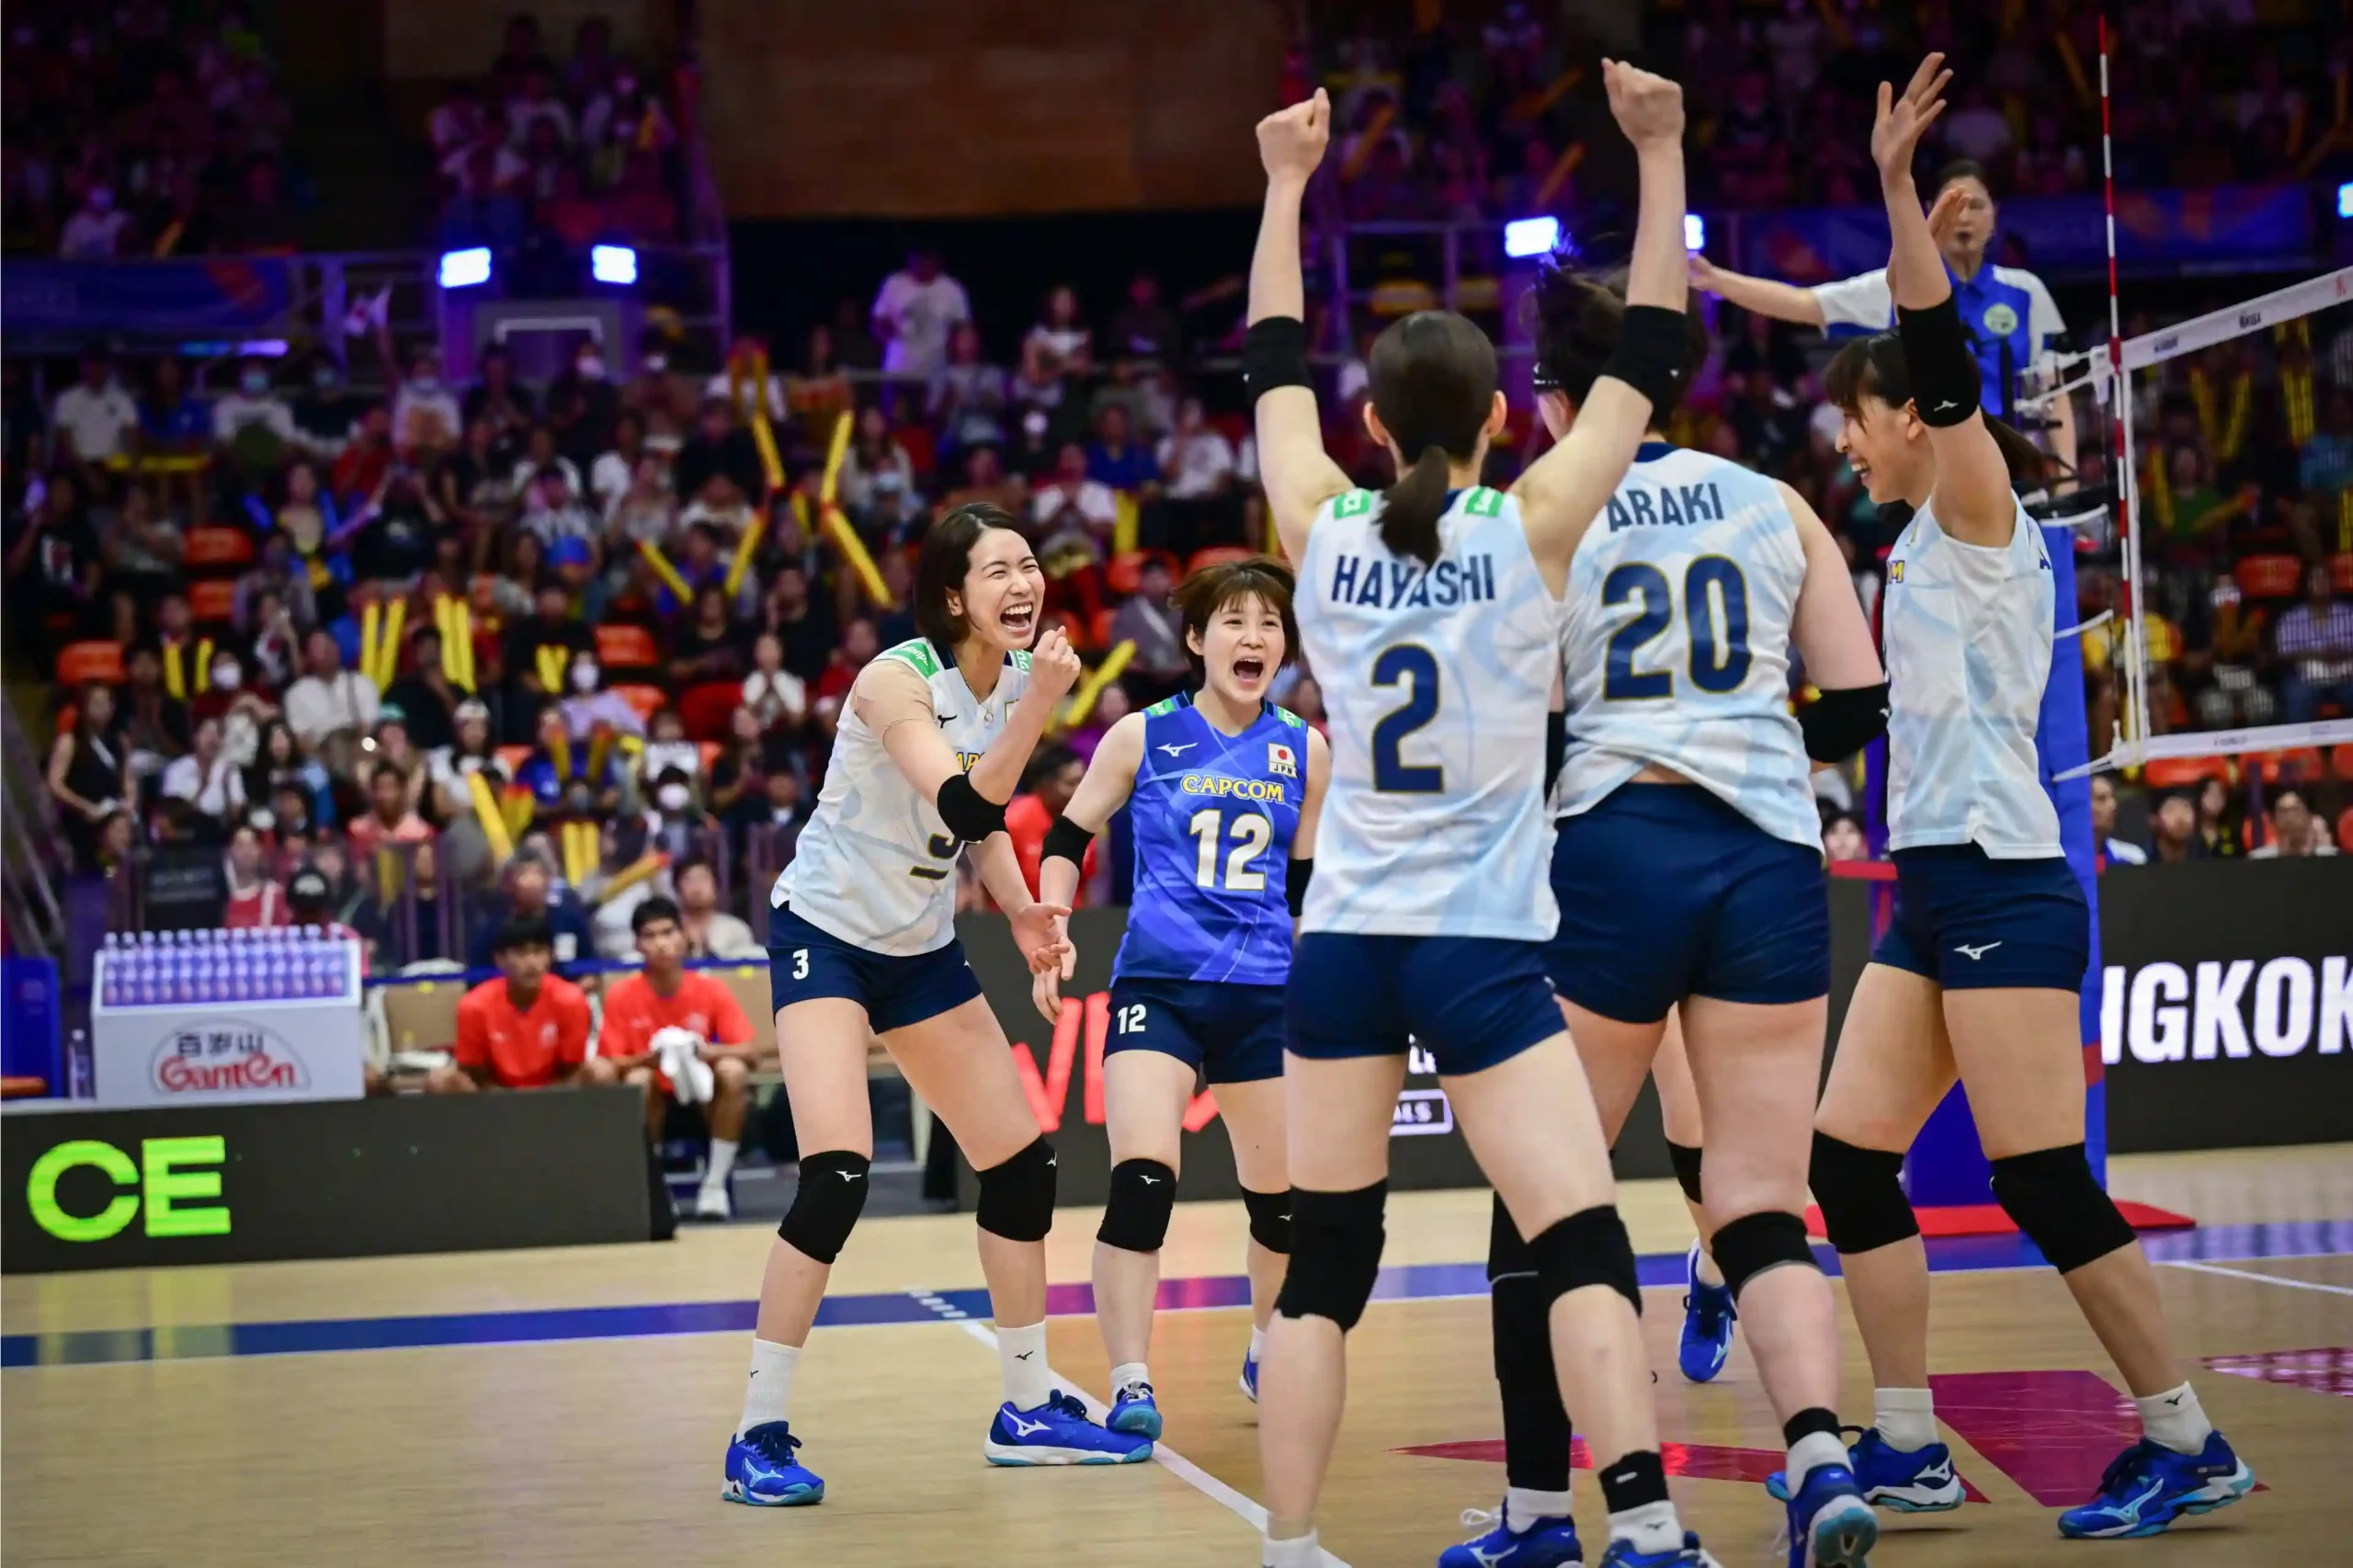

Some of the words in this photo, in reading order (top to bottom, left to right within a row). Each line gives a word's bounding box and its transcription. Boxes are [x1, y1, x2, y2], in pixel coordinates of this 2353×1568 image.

[1607, 483, 1724, 532] ARAKI
[1331, 553, 1495, 609] HAYASHI
[1601, 553, 1753, 701] 20
[1370, 642, 1445, 794] 2
[1181, 774, 1285, 803] CAPCOM
[1273, 764, 1293, 775] JPN
[1189, 809, 1273, 892] 12
[792, 949, 809, 980] 3
[1117, 1004, 1147, 1035] 12
[28, 1136, 231, 1242] CE
